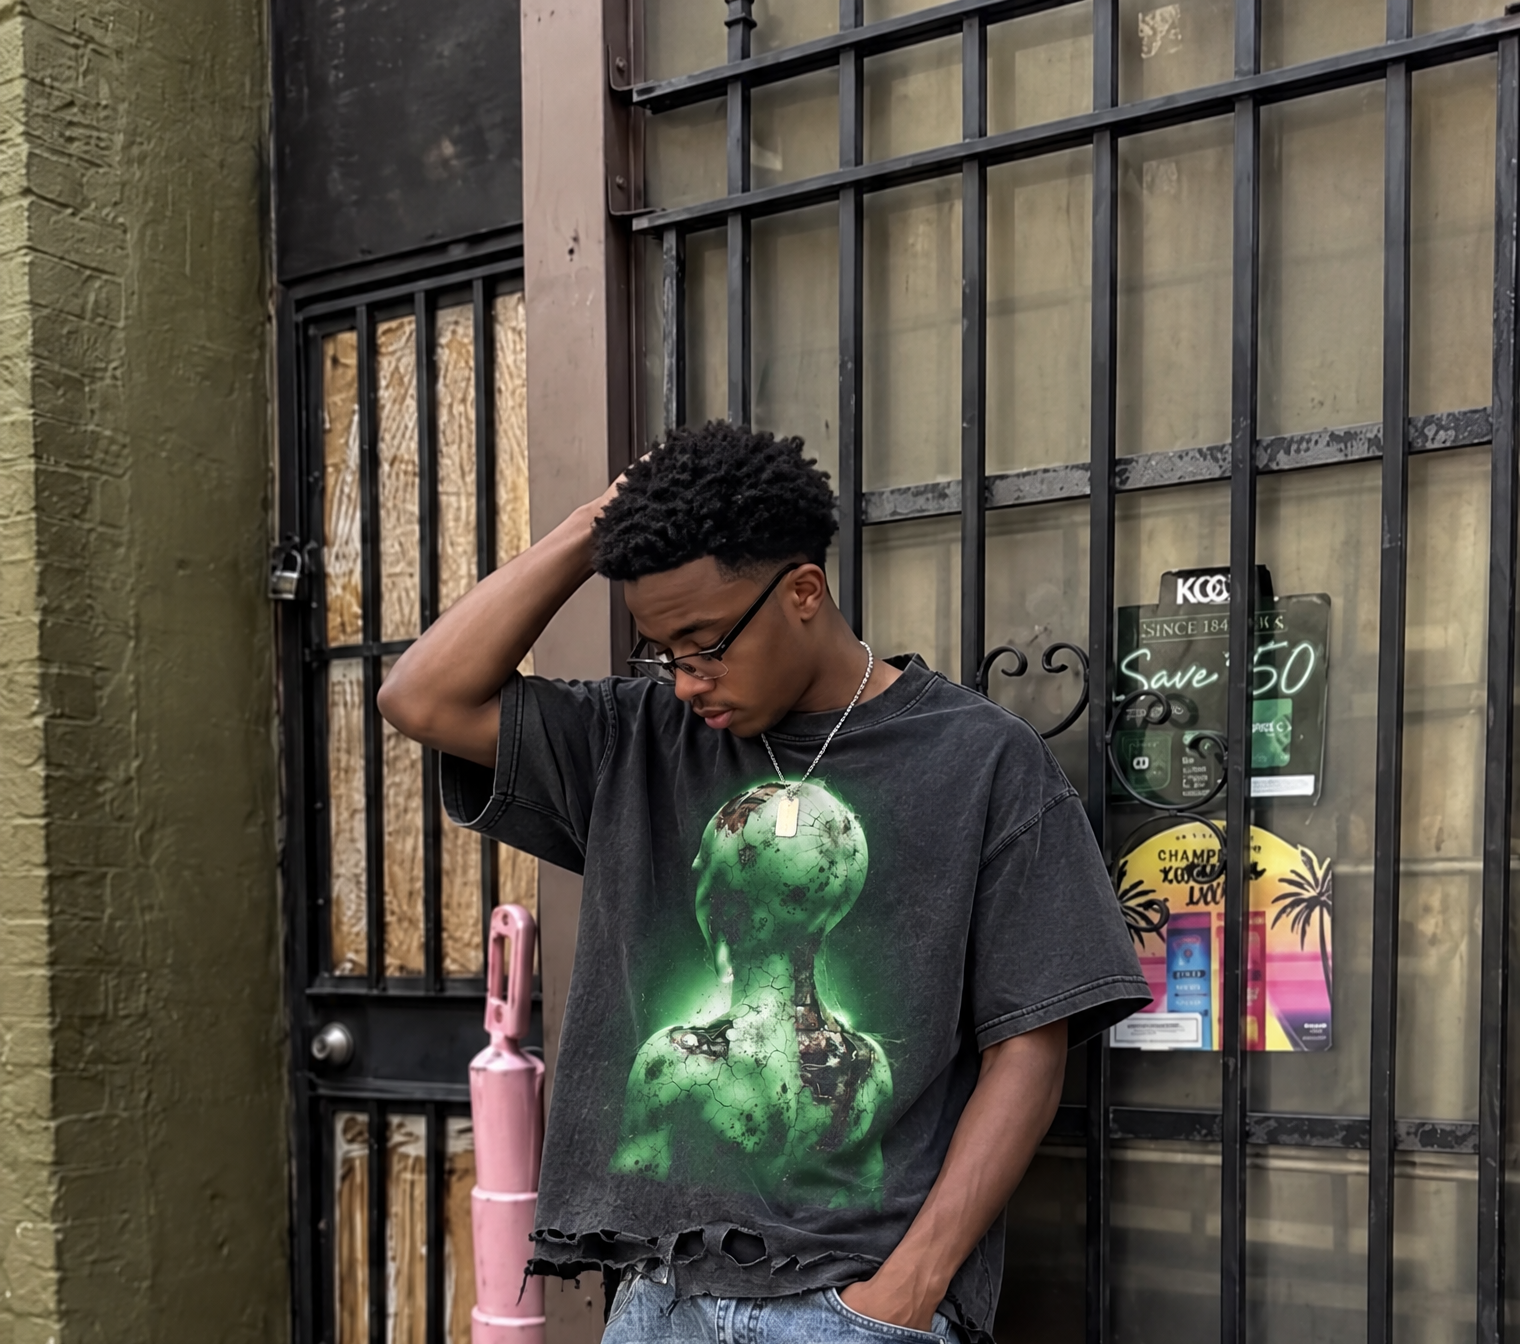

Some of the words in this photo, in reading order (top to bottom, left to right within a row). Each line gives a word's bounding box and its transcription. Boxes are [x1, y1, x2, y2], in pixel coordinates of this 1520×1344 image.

[1142, 620, 1198, 638] SINCE
[1203, 619, 1229, 634] 184
[1114, 648, 1220, 700] Save
